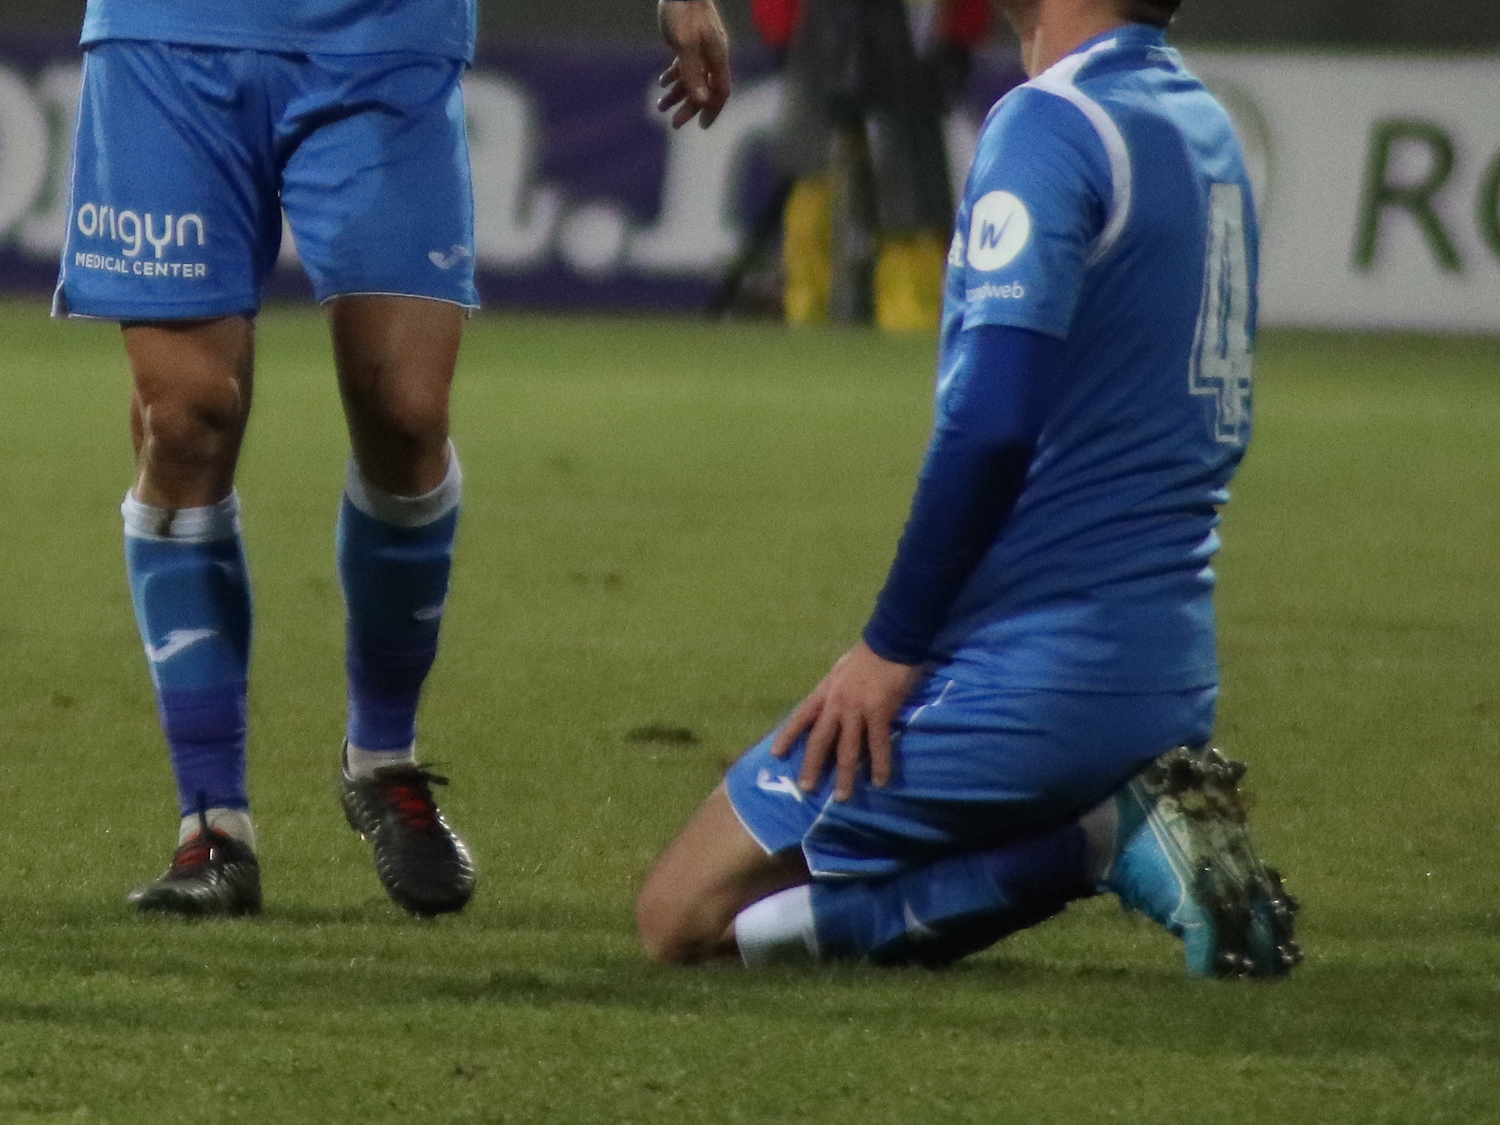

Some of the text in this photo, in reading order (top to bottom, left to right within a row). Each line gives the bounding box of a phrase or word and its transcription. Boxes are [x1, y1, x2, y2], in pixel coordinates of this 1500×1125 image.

[77, 203, 205, 260] origyn
[1349, 115, 1500, 275] R
[75, 252, 206, 278] MEDICAL CENTER
[1188, 182, 1254, 443] 4
